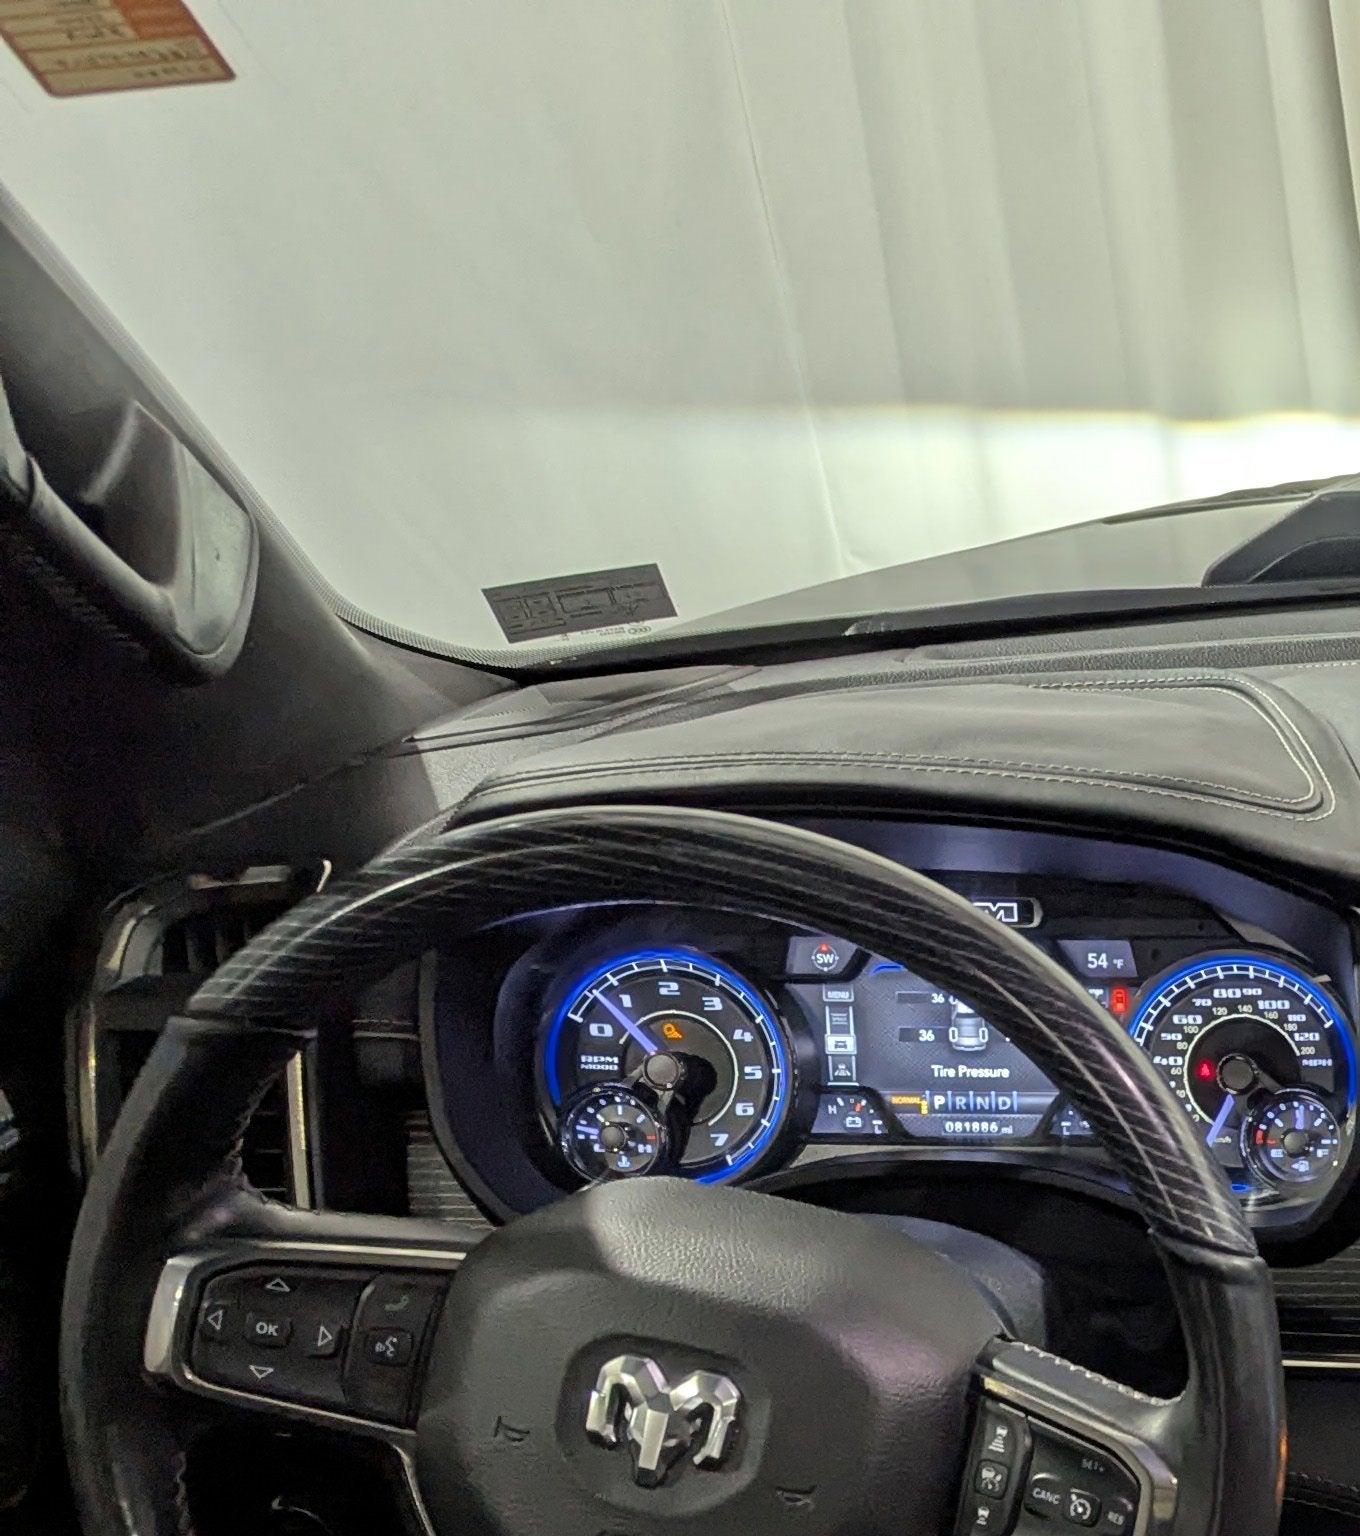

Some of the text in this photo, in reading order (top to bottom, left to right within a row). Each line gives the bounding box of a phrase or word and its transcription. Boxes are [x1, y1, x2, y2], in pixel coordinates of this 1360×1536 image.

[816, 953, 834, 964] SW
[1087, 953, 1108, 969] 54
[658, 982, 680, 995] 2
[1213, 989, 1241, 998] 80
[1243, 988, 1262, 996] 90
[827, 991, 849, 999] MENU
[932, 994, 945, 1003] 36
[619, 994, 632, 1007] 1
[702, 997, 723, 1010] 3
[1192, 999, 1212, 1007] 70
[1257, 1000, 1290, 1010] 100
[1212, 1007, 1227, 1016] 120
[1238, 1005, 1252, 1013] 140
[1172, 1015, 1202, 1025] 60
[1287, 1014, 1306, 1022] 110
[589, 1023, 613, 1037] 0
[1184, 1025, 1199, 1034] 100
[733, 1029, 753, 1041] 4
[919, 1029, 935, 1042] 36
[1161, 1032, 1182, 1041] 50
[1293, 1032, 1320, 1041] 120
[1177, 1041, 1188, 1050] 80
[1300, 1046, 1315, 1055] 200
[581, 1055, 619, 1064] RPM
[1302, 1059, 1332, 1067] MPH
[744, 1065, 762, 1079] 5
[931, 1065, 1010, 1078] Tire Pressure
[934, 1095, 1011, 1110] P R N D
[735, 1103, 755, 1116] 6
[945, 1121, 998, 1133] 081886
[710, 1133, 728, 1146] 7
[256, 1322, 279, 1336] OK
[1032, 1487, 1061, 1505] CANC
